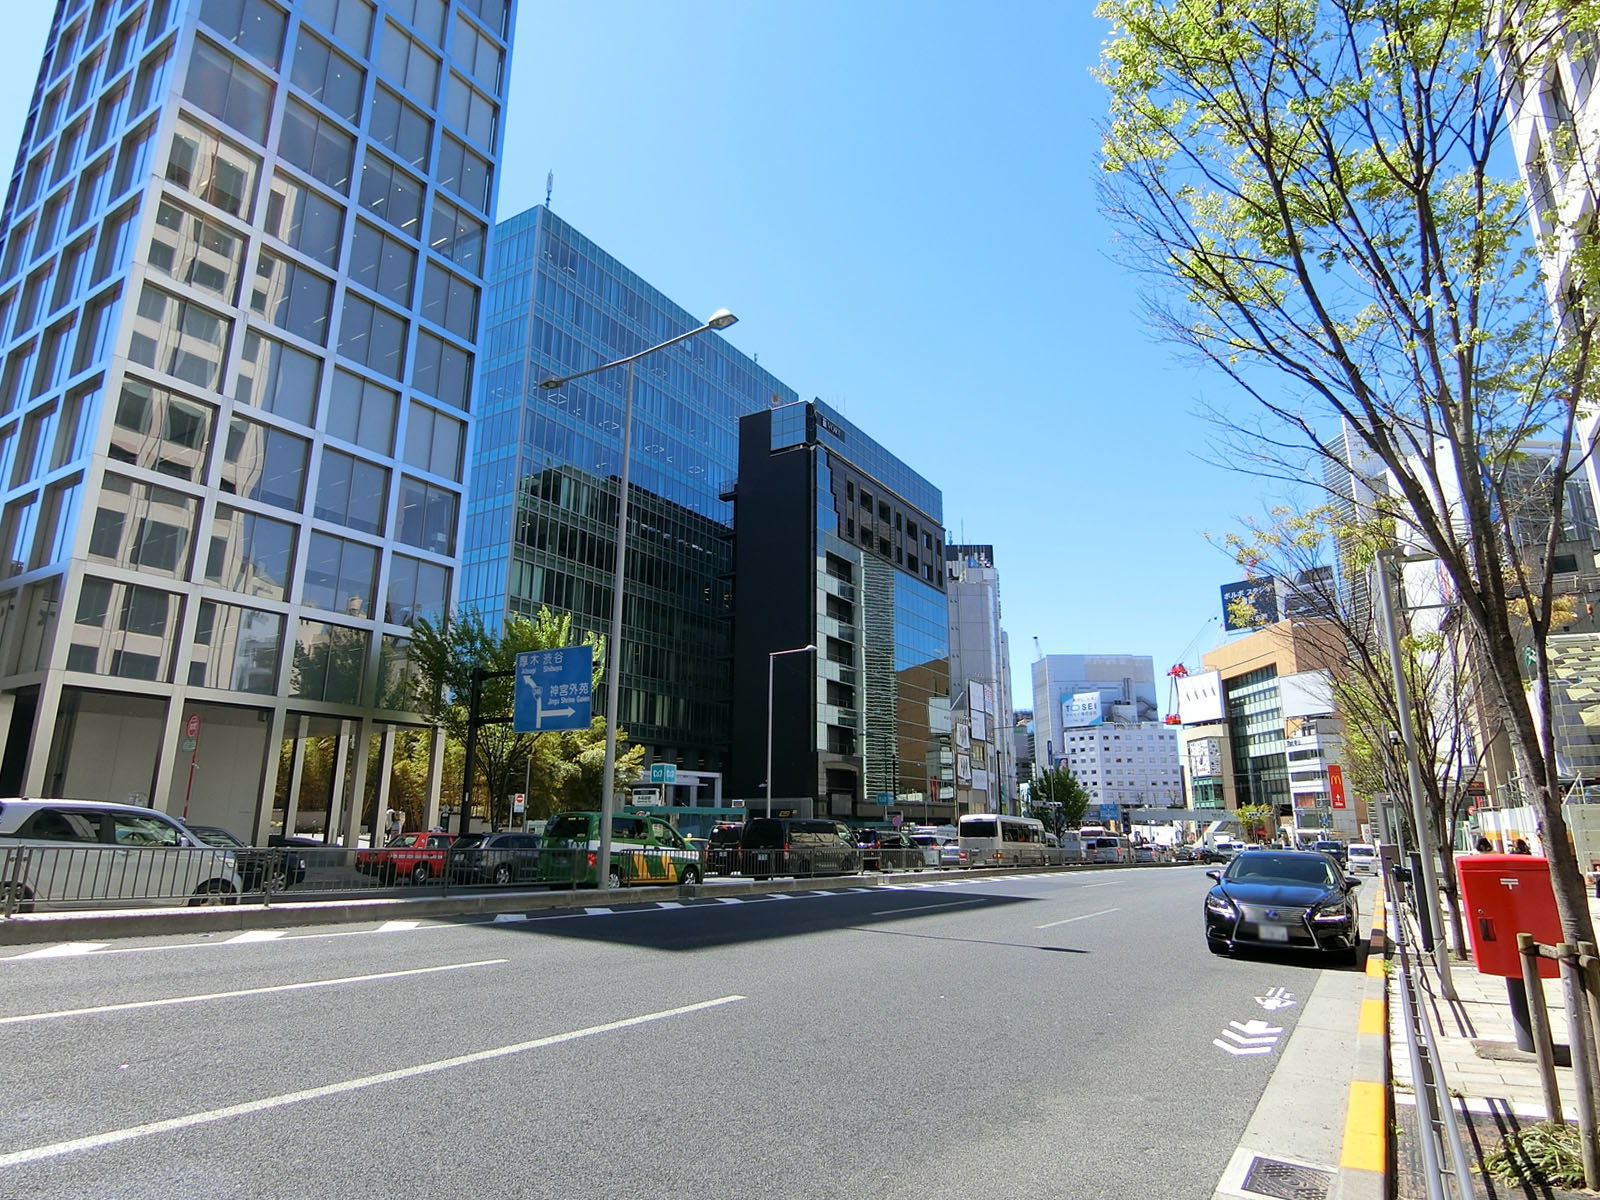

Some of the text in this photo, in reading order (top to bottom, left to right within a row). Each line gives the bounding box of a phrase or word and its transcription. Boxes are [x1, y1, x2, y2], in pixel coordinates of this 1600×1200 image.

[1224, 590, 1244, 600] ボルボ
[519, 651, 564, 668] 厚木 渋谷
[543, 665, 563, 673] Shibuya
[550, 683, 589, 697] 神宮外苑
[1065, 702, 1098, 713] TOSEI
[568, 839, 587, 850] TAXI
